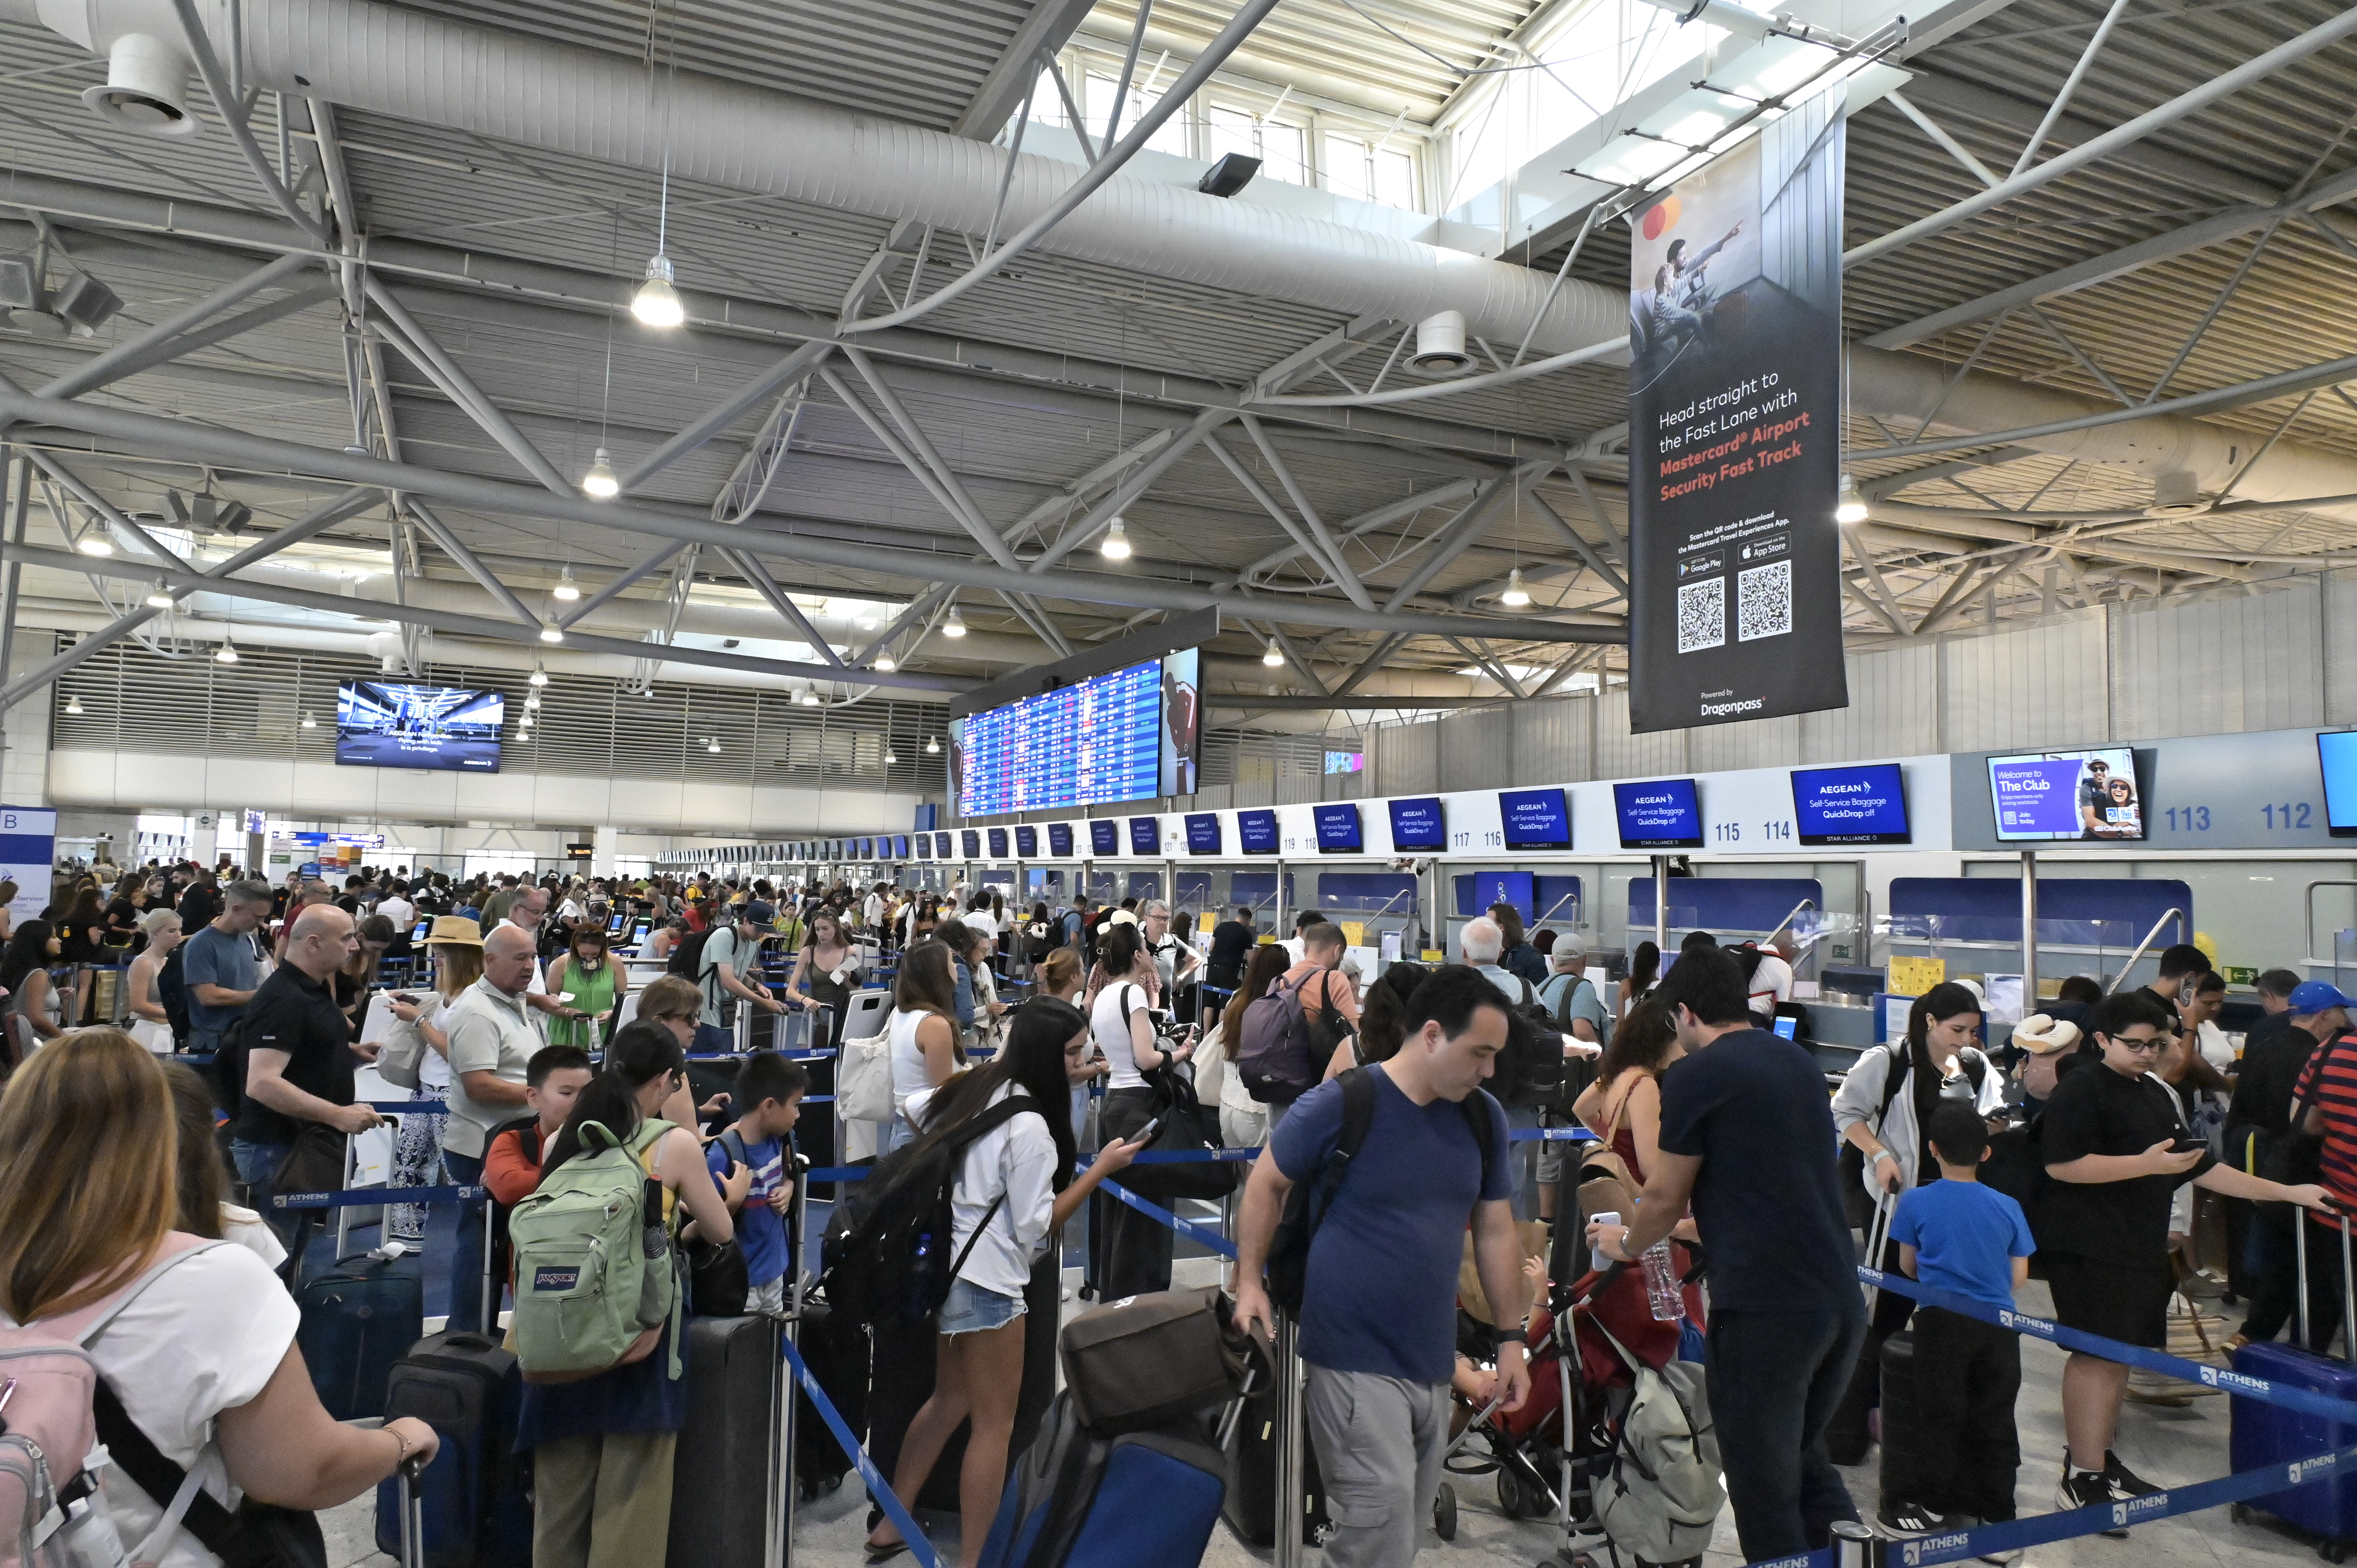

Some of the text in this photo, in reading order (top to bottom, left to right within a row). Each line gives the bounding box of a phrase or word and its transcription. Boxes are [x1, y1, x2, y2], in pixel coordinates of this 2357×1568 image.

[1660, 373, 1778, 429] Head straight to
[1660, 388, 1797, 453] the Fast Lane with
[1751, 411, 1810, 445] Airport
[1661, 440, 1801, 501] Security Fast Track
[1689, 533, 1703, 541] Scan
[1724, 522, 1737, 531] code
[1745, 510, 1774, 525] download
[1688, 537, 1719, 551] Mastercard
[1720, 531, 1737, 542] Travel
[1739, 523, 1774, 537] Experiences
[1775, 518, 1790, 527] App.
[1754, 539, 1772, 547] Download
[1754, 543, 1786, 557] App Store
[1691, 560, 1721, 572] Google Play
[1701, 689, 1725, 699] Powered
[1701, 699, 1762, 716] Dragonpass
[1820, 784, 1861, 794] AEGEAN
[1999, 779, 2050, 792] The Club
[1635, 796, 1666, 804] AEGEAN
[1809, 798, 1886, 808] Self-Service Baggage
[1659, 808, 1685, 816] Baggage
[1823, 810, 1863, 819] QuickDrop
[2165, 806, 2210, 831] 113
[2261, 802, 2311, 829] 112
[4, 814, 17, 828] B
[1716, 823, 1739, 841] 115
[1764, 821, 1790, 840] 114
[1180, 841, 1188, 851] 120
[1285, 837, 1295, 849] 119
[1305, 837, 1316, 849] 118
[1454, 832, 1469, 847] 117
[1485, 831, 1501, 846] 116
[537, 1273, 576, 1285] JANSPORT
[1857, 1265, 1883, 1280] THENS
[2014, 1314, 2054, 1332] ATHENS
[2218, 1370, 2269, 1390] ATHENS
[2302, 1453, 2336, 1471] ATHENS
[2127, 1494, 2168, 1512] ATHENS
[1921, 1533, 1968, 1551] ATHENS
